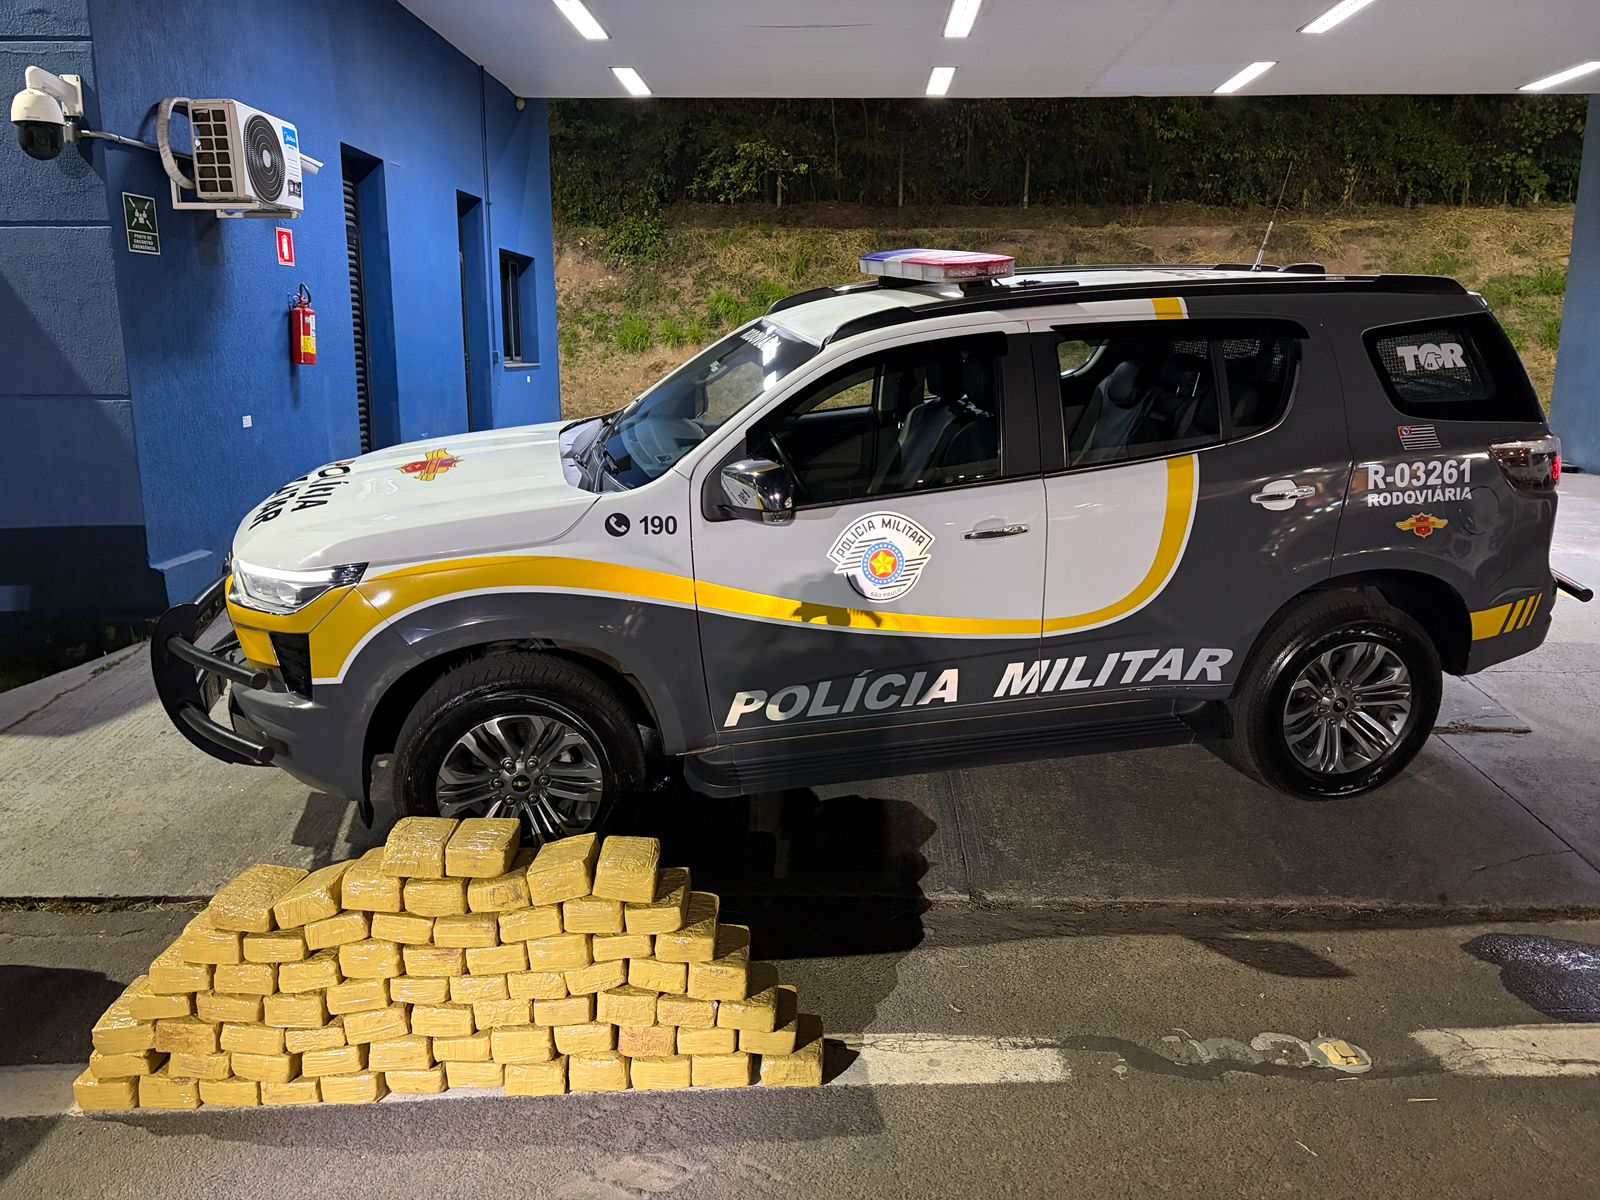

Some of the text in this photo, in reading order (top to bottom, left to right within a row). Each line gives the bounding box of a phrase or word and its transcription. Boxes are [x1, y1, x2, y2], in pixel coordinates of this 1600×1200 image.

[1396, 343, 1467, 372] TOR
[1367, 458, 1471, 490] R-03261
[1367, 486, 1472, 507] RODOVIÁRIA
[639, 515, 678, 535] 190
[881, 518, 925, 546] MILITAR
[883, 587, 902, 597] PAULO
[724, 648, 1234, 728] POLÍCIA MILITAR
